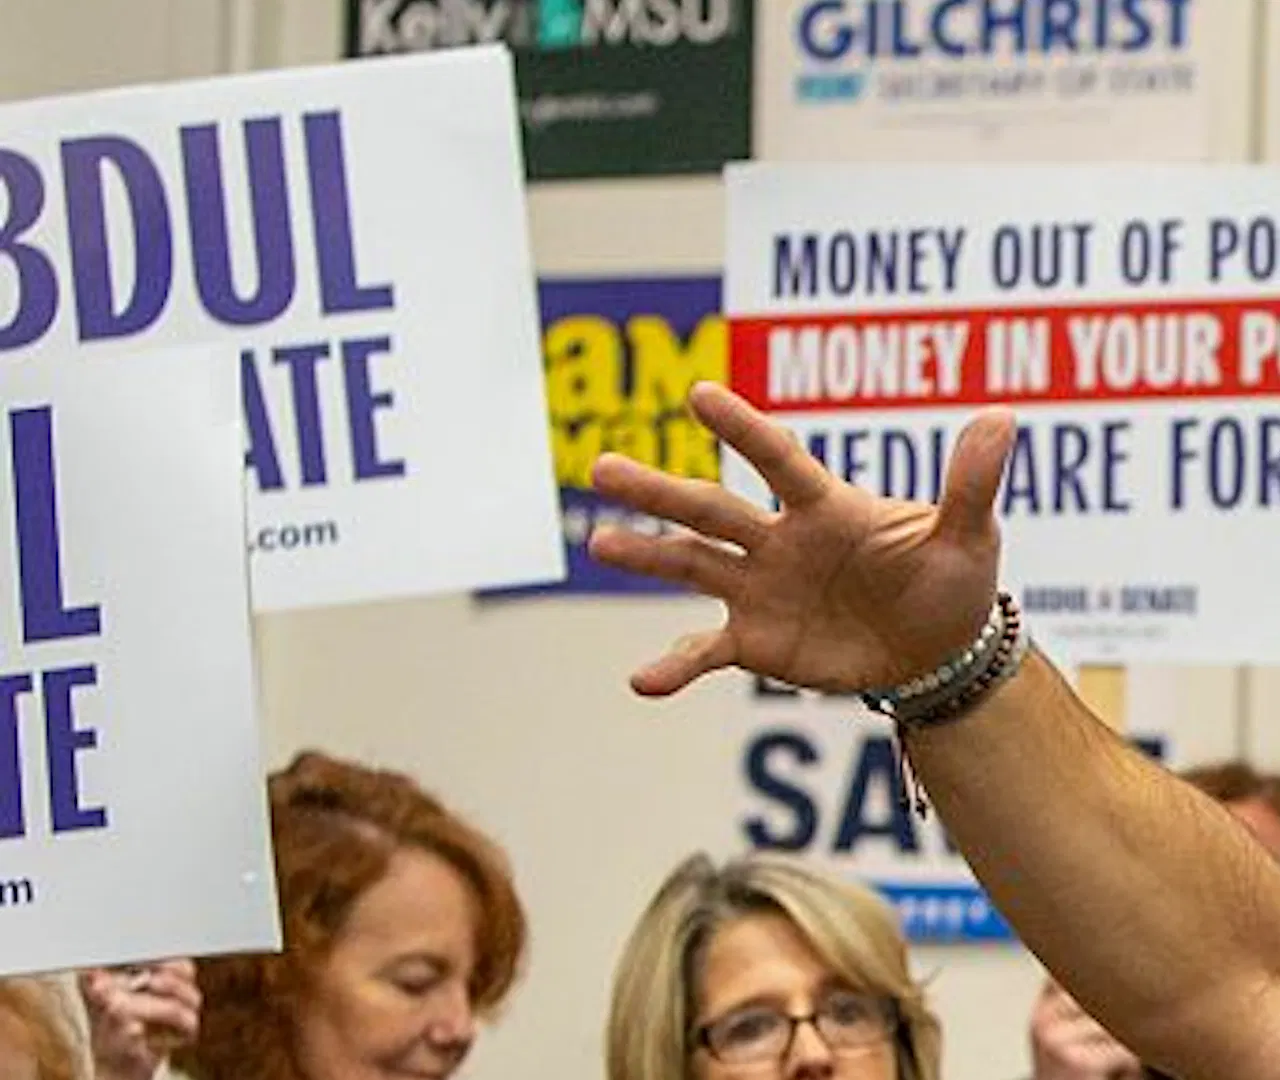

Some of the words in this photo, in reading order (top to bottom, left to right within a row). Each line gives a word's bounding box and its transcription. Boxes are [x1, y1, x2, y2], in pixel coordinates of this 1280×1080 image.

[800, 0, 1195, 61] GILCHRIST
[773, 229, 967, 298] MONEY
[992, 223, 1092, 289] OUT
[1119, 219, 1183, 285] OF
[767, 319, 971, 400] MONEY
[985, 315, 1046, 393] IN
[1066, 310, 1220, 391] YOUR
